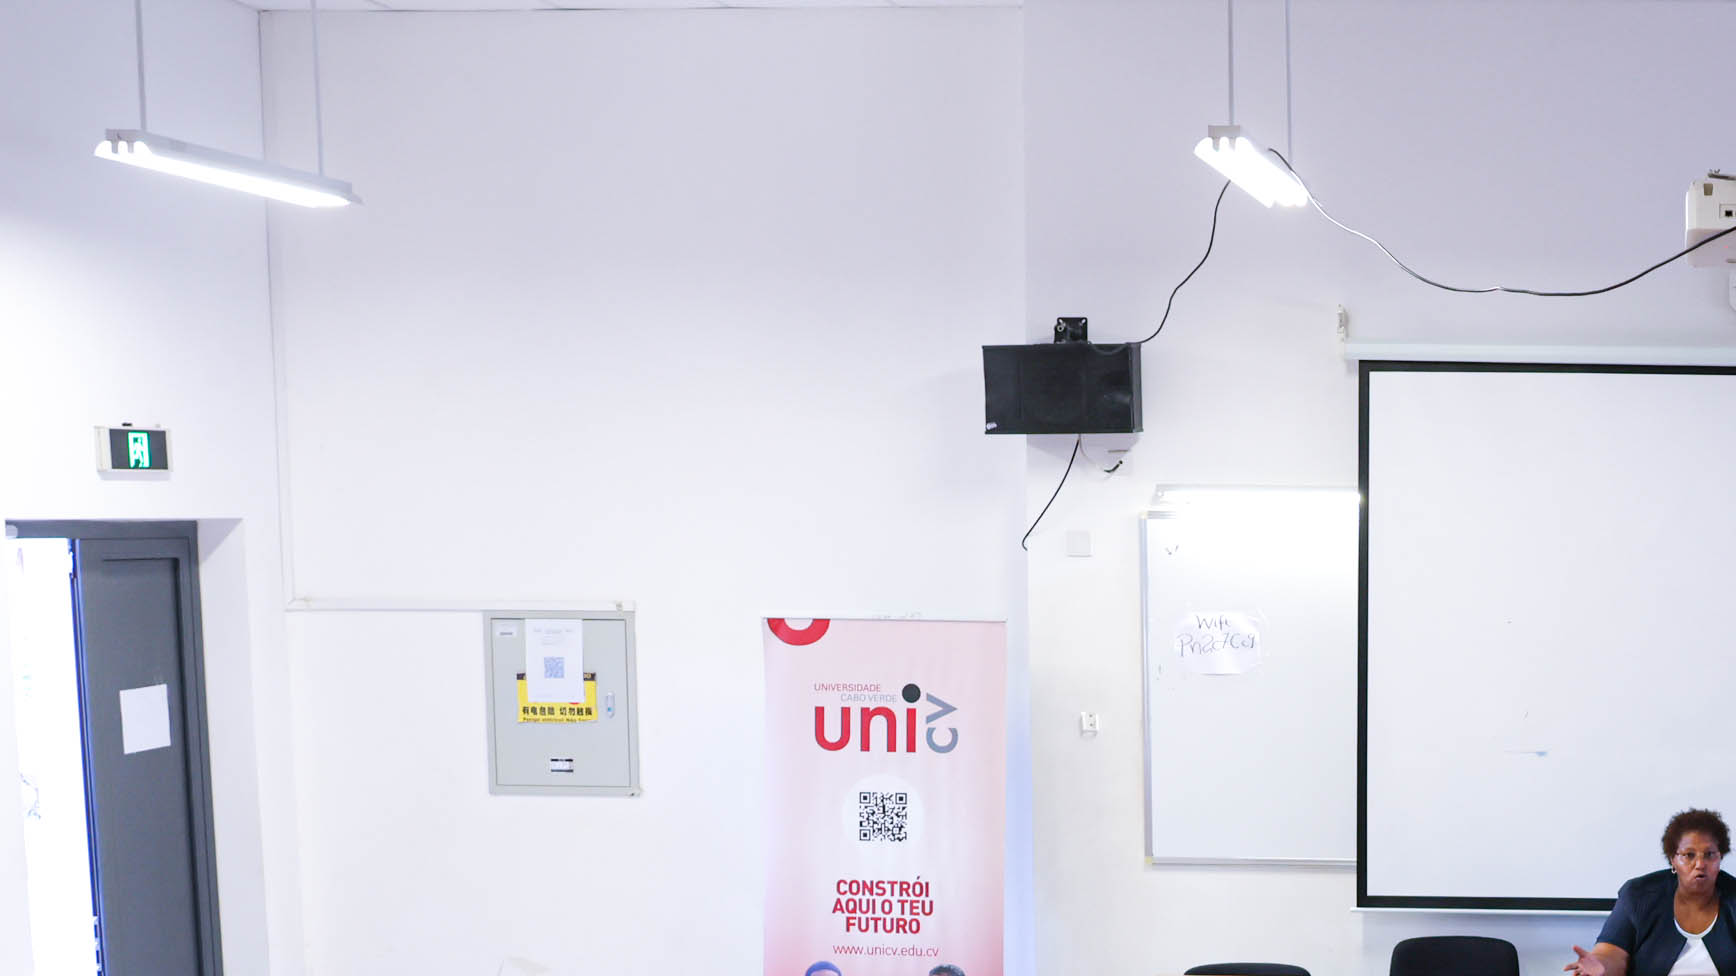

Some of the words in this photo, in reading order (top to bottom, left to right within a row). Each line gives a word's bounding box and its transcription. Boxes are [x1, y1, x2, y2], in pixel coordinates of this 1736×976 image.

[814, 683, 881, 693] UNIVERSIDADE
[840, 693, 866, 702] CABO
[867, 694, 897, 703] VERDE
[836, 875, 930, 898] CONSTRÓI
[832, 897, 876, 915] AQUI
[881, 899, 893, 915] O
[897, 899, 934, 916] TEU
[845, 916, 921, 934] FUTURO
[832, 944, 939, 957] www.unicv.edu.cv
